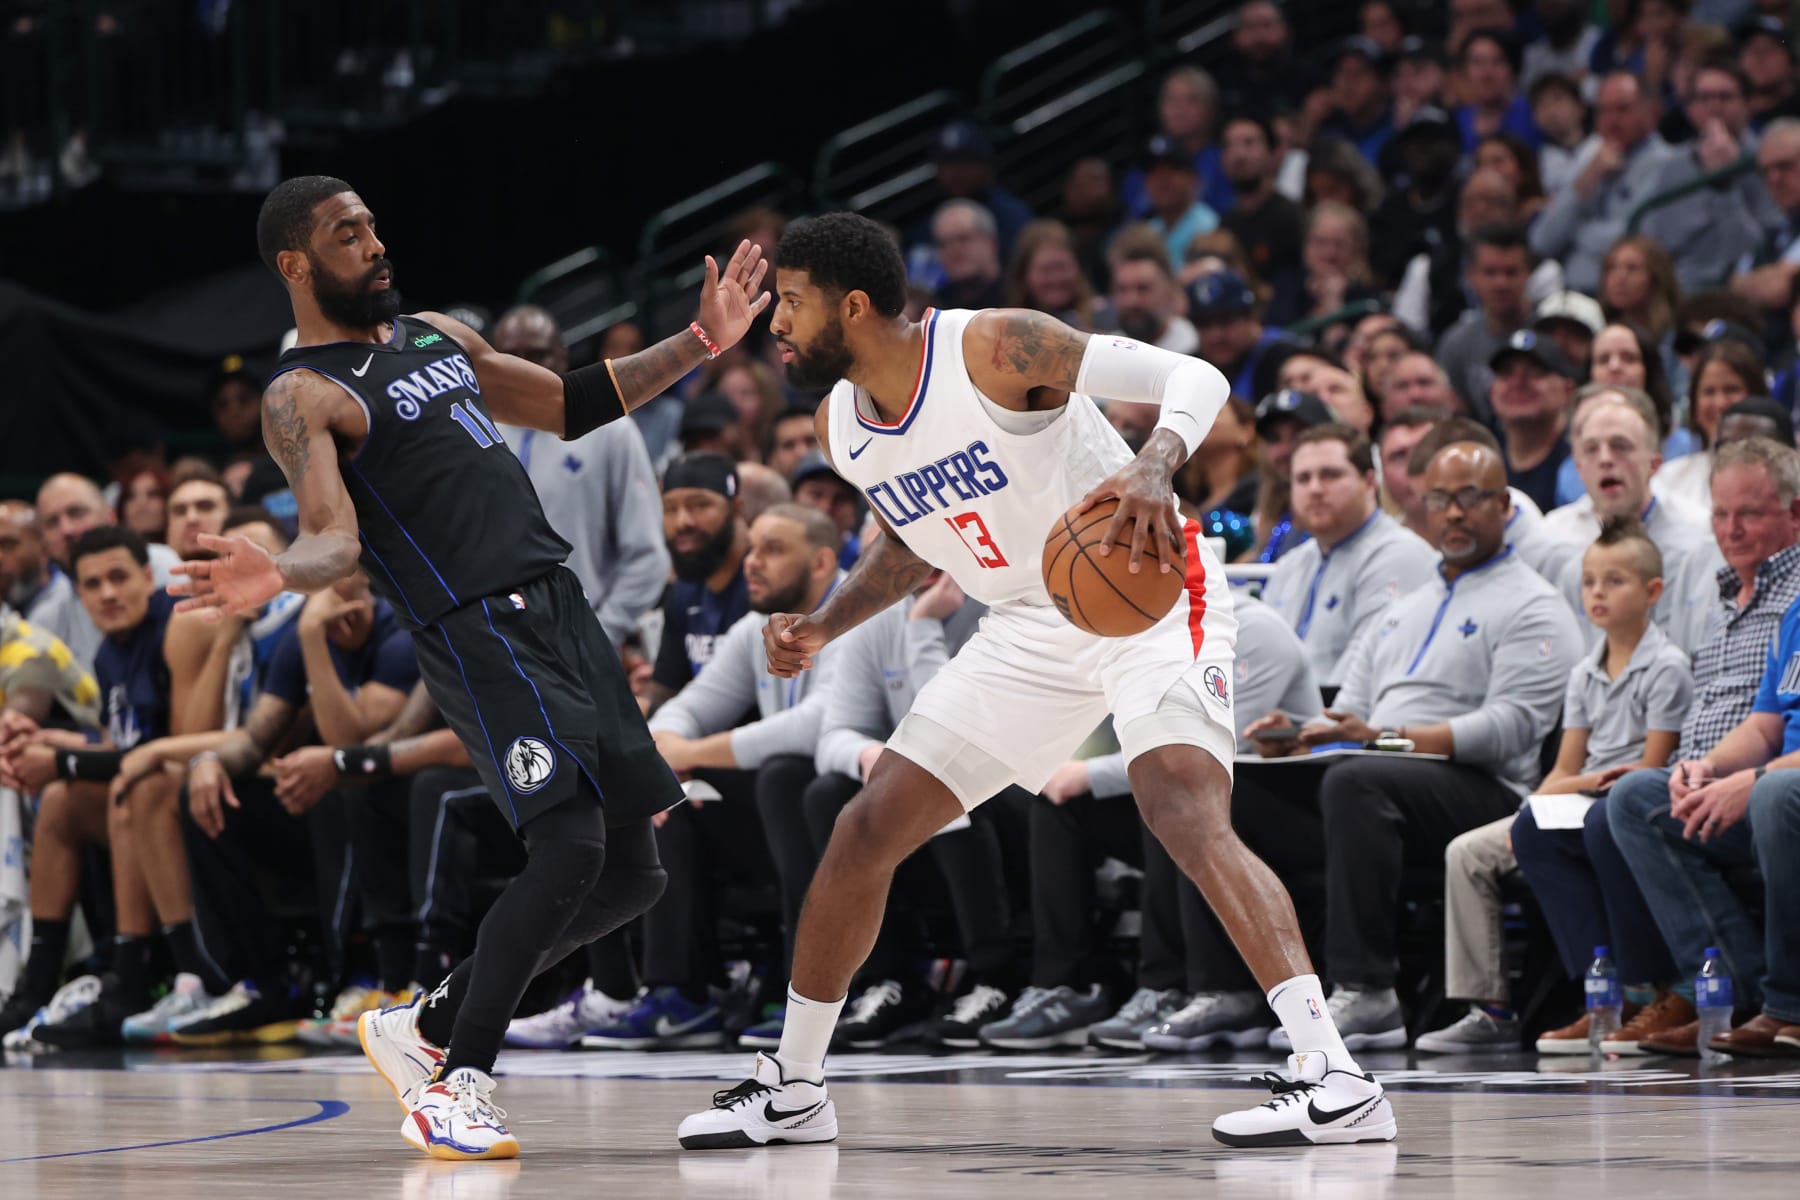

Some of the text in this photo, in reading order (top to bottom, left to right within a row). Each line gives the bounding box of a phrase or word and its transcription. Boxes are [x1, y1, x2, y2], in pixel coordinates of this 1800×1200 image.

[414, 333, 443, 348] chime
[386, 353, 481, 422] MAVS
[450, 398, 504, 449] 11
[865, 440, 1009, 527] CLIPPERS
[944, 511, 1010, 569] 13
